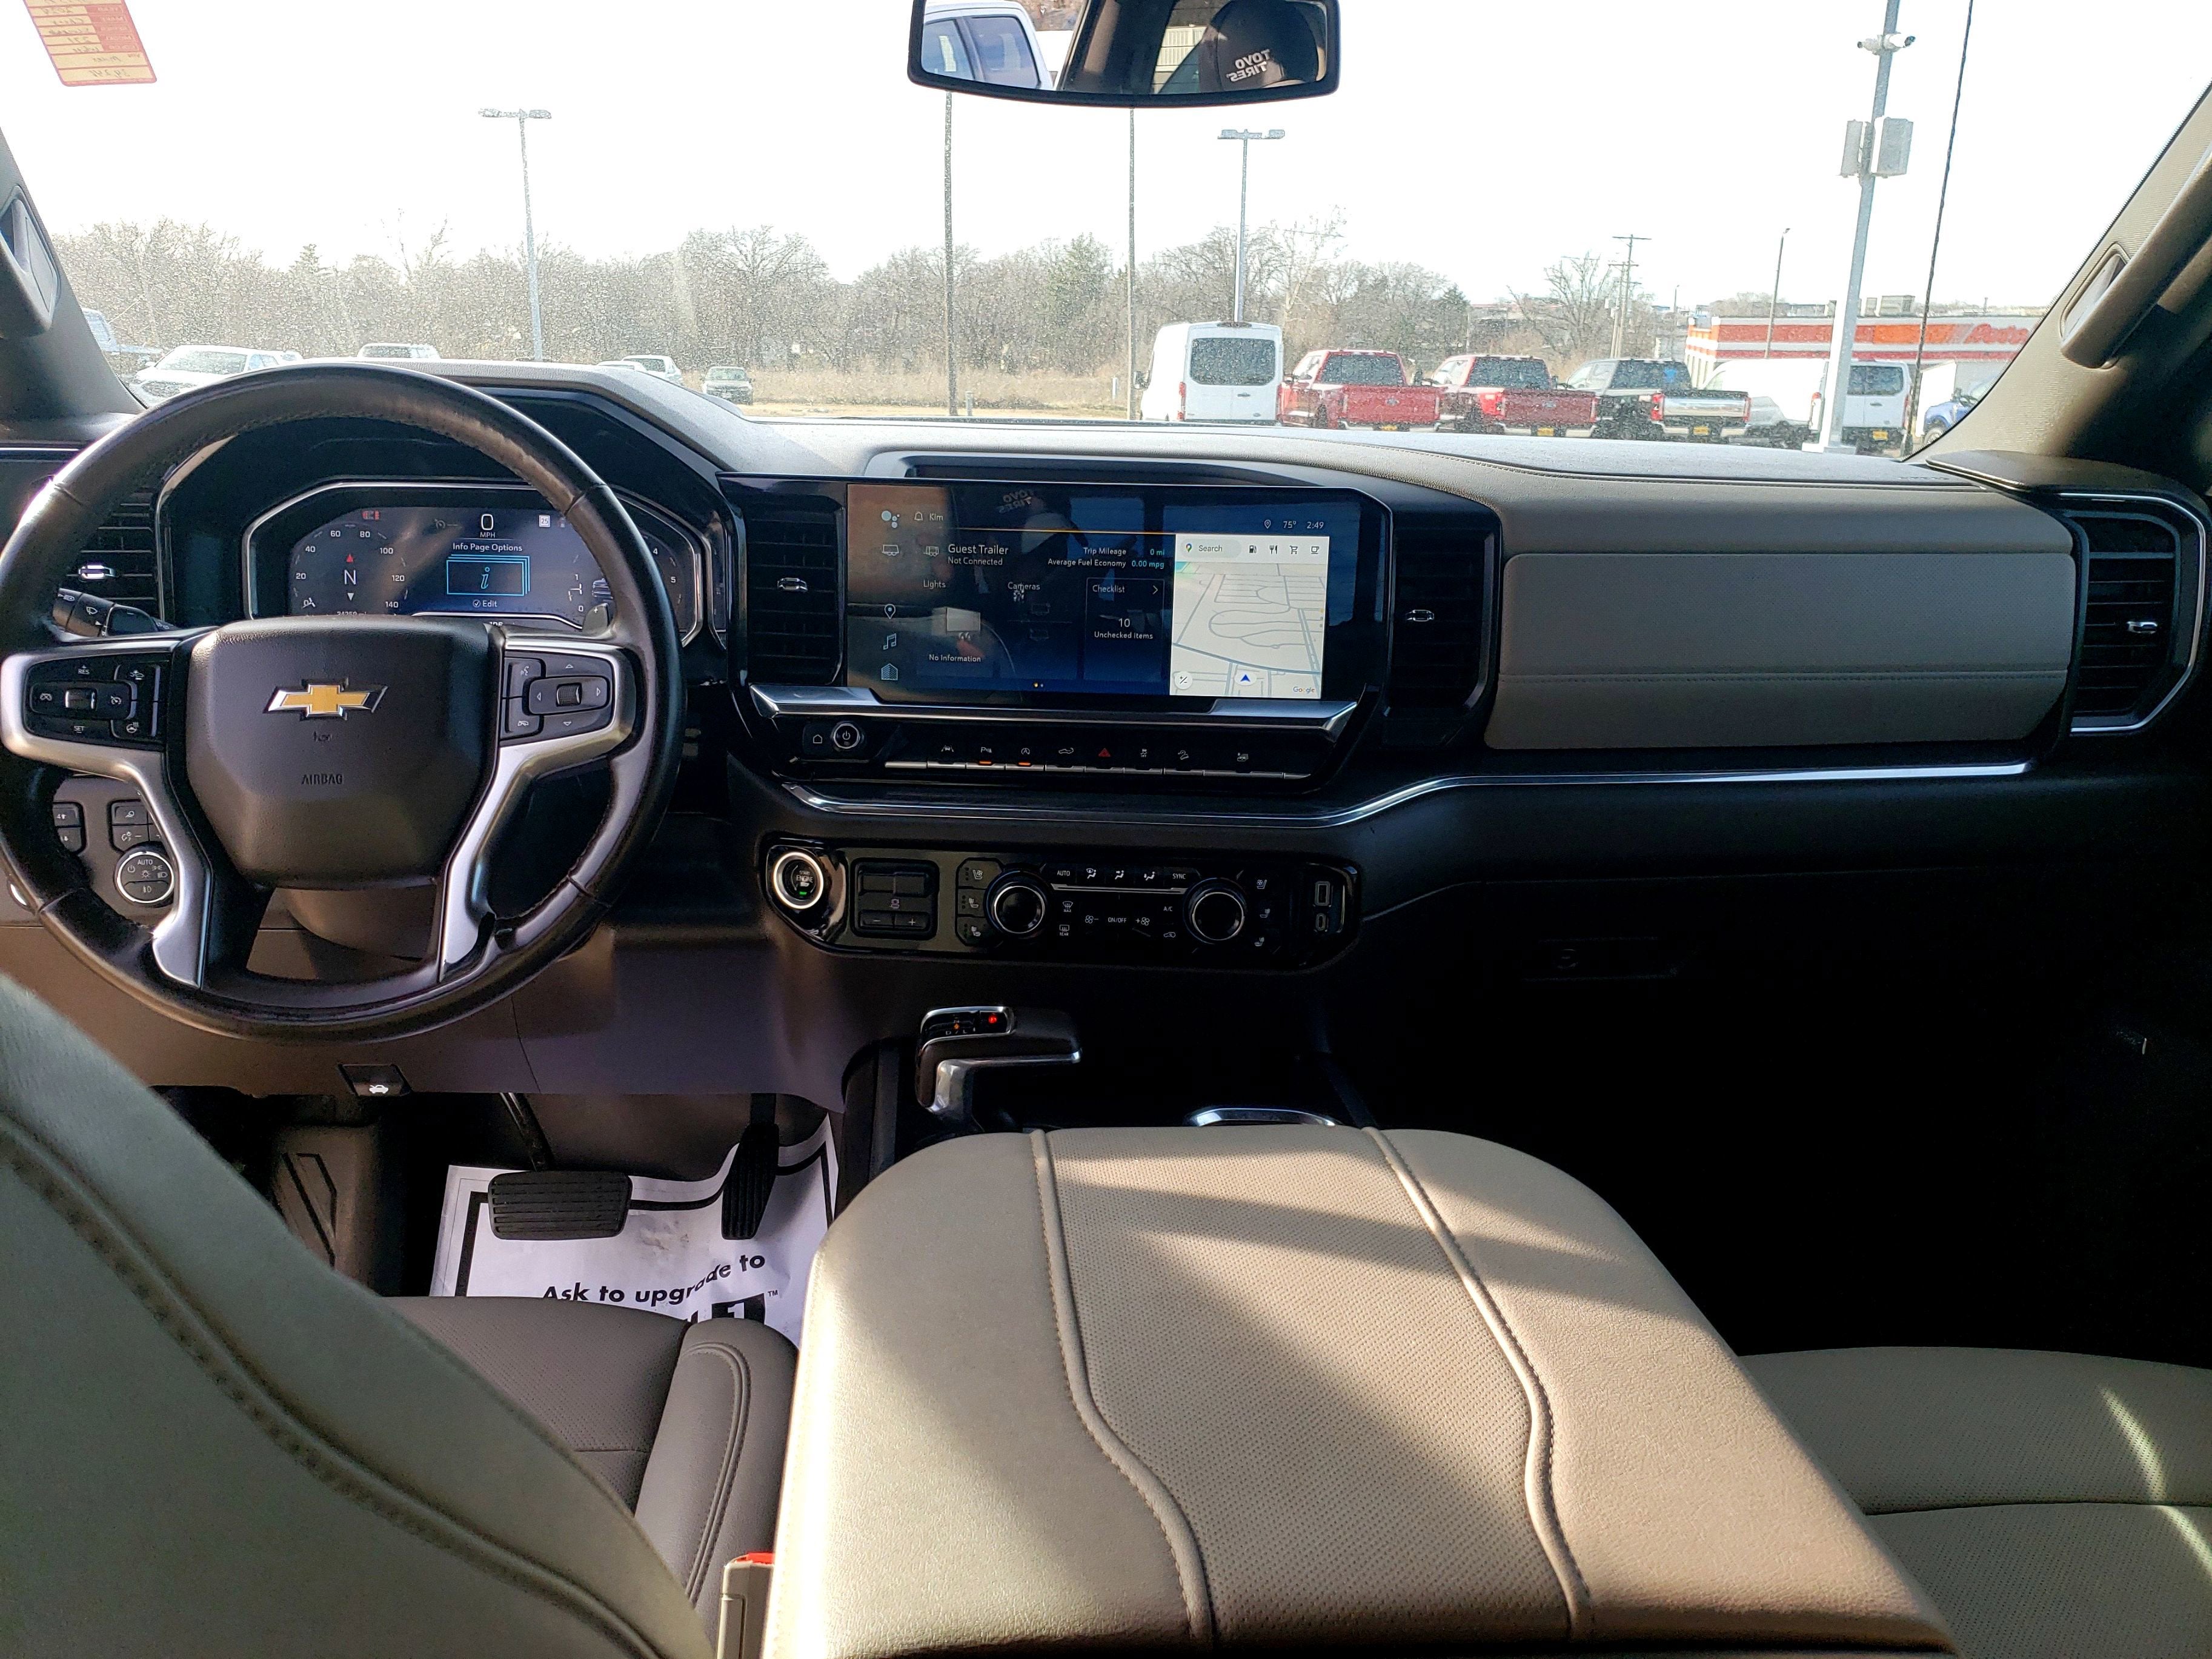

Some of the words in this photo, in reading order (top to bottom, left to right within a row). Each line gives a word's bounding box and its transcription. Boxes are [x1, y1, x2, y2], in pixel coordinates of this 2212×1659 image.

[480, 513, 494, 531] 0
[929, 513, 944, 521] Kim
[1283, 520, 1297, 529] 75°
[1306, 521, 1324, 530] 2:49
[453, 542, 469, 551] Info
[470, 543, 490, 553] Page
[491, 544, 523, 553] Options
[948, 544, 977, 554] Guest
[979, 544, 1009, 555] Trailer
[1083, 547, 1097, 556] Trip
[1098, 547, 1127, 557] Mileage
[1198, 544, 1223, 553] Search
[963, 557, 1003, 566] Connected
[1048, 558, 1076, 567] Average
[1094, 559, 1127, 568] Economy
[1148, 561, 1165, 570] mpg
[344, 569, 357, 585] N
[923, 579, 946, 590] Lights
[1007, 581, 1041, 591] Cameras
[1092, 584, 1126, 594] Checklist
[482, 600, 498, 608] Edit
[1118, 617, 1131, 628] 10
[1094, 631, 1132, 640] Unchecked
[940, 654, 981, 663] Information
[1292, 686, 1316, 694] Google
[301, 773, 344, 785] AIRBAG
[542, 1282, 591, 1302] Ask
[599, 1285, 625, 1302] to
[634, 1263, 732, 1308] upgrade
[739, 1254, 766, 1272] to
